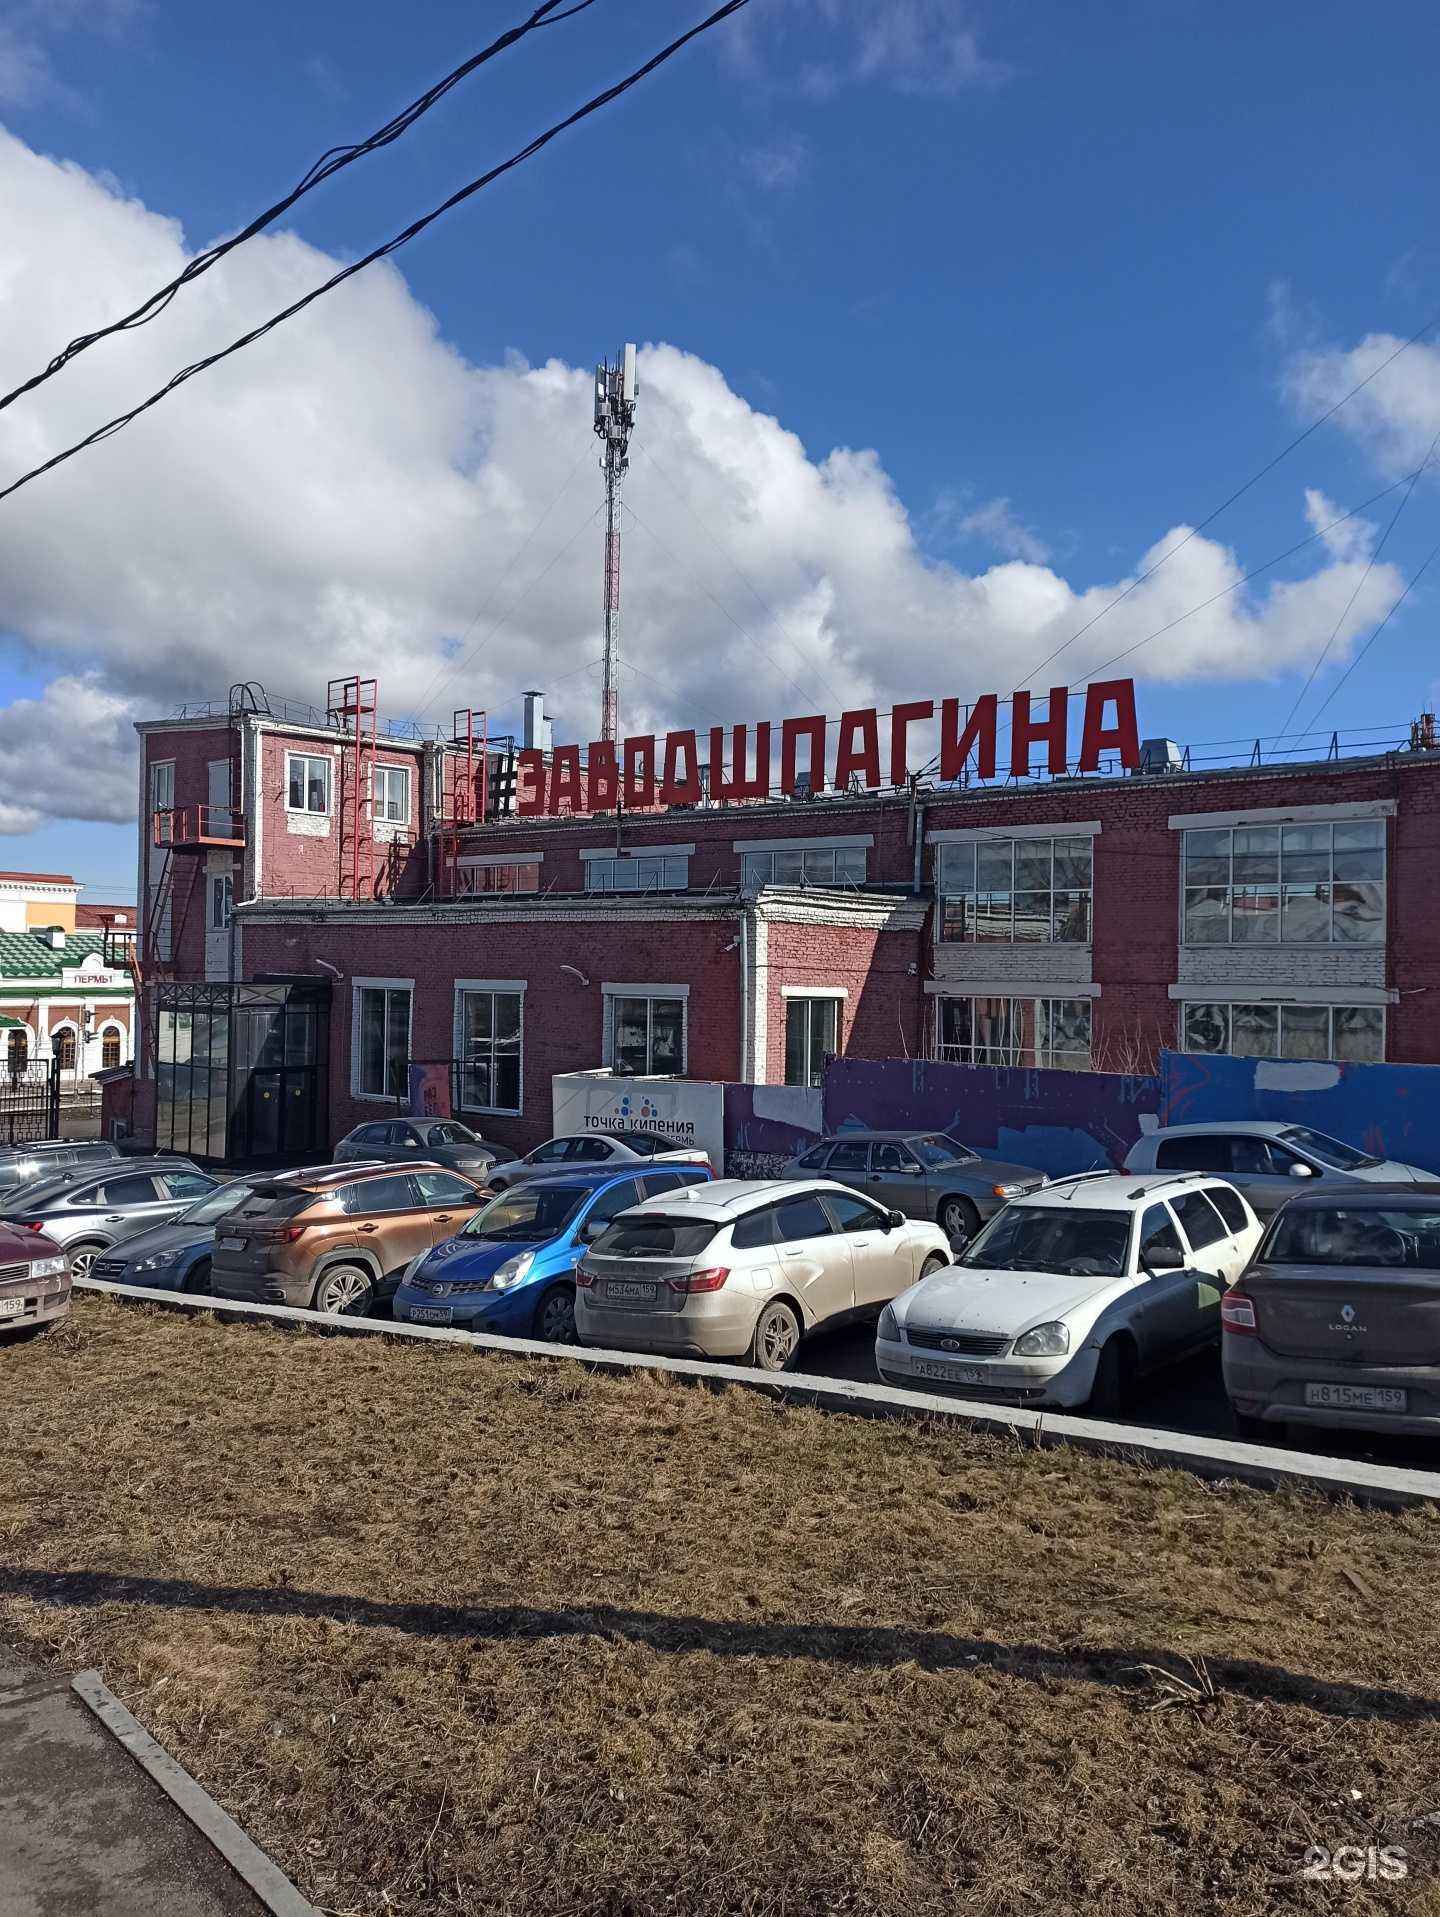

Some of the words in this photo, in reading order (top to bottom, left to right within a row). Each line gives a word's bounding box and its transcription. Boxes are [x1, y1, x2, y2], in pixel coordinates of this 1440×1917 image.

[490, 678, 1141, 816] #ЗАВОДШПАГИНА
[630, 1118, 695, 1135] кипения
[1328, 1323, 1368, 1333] LOGAN
